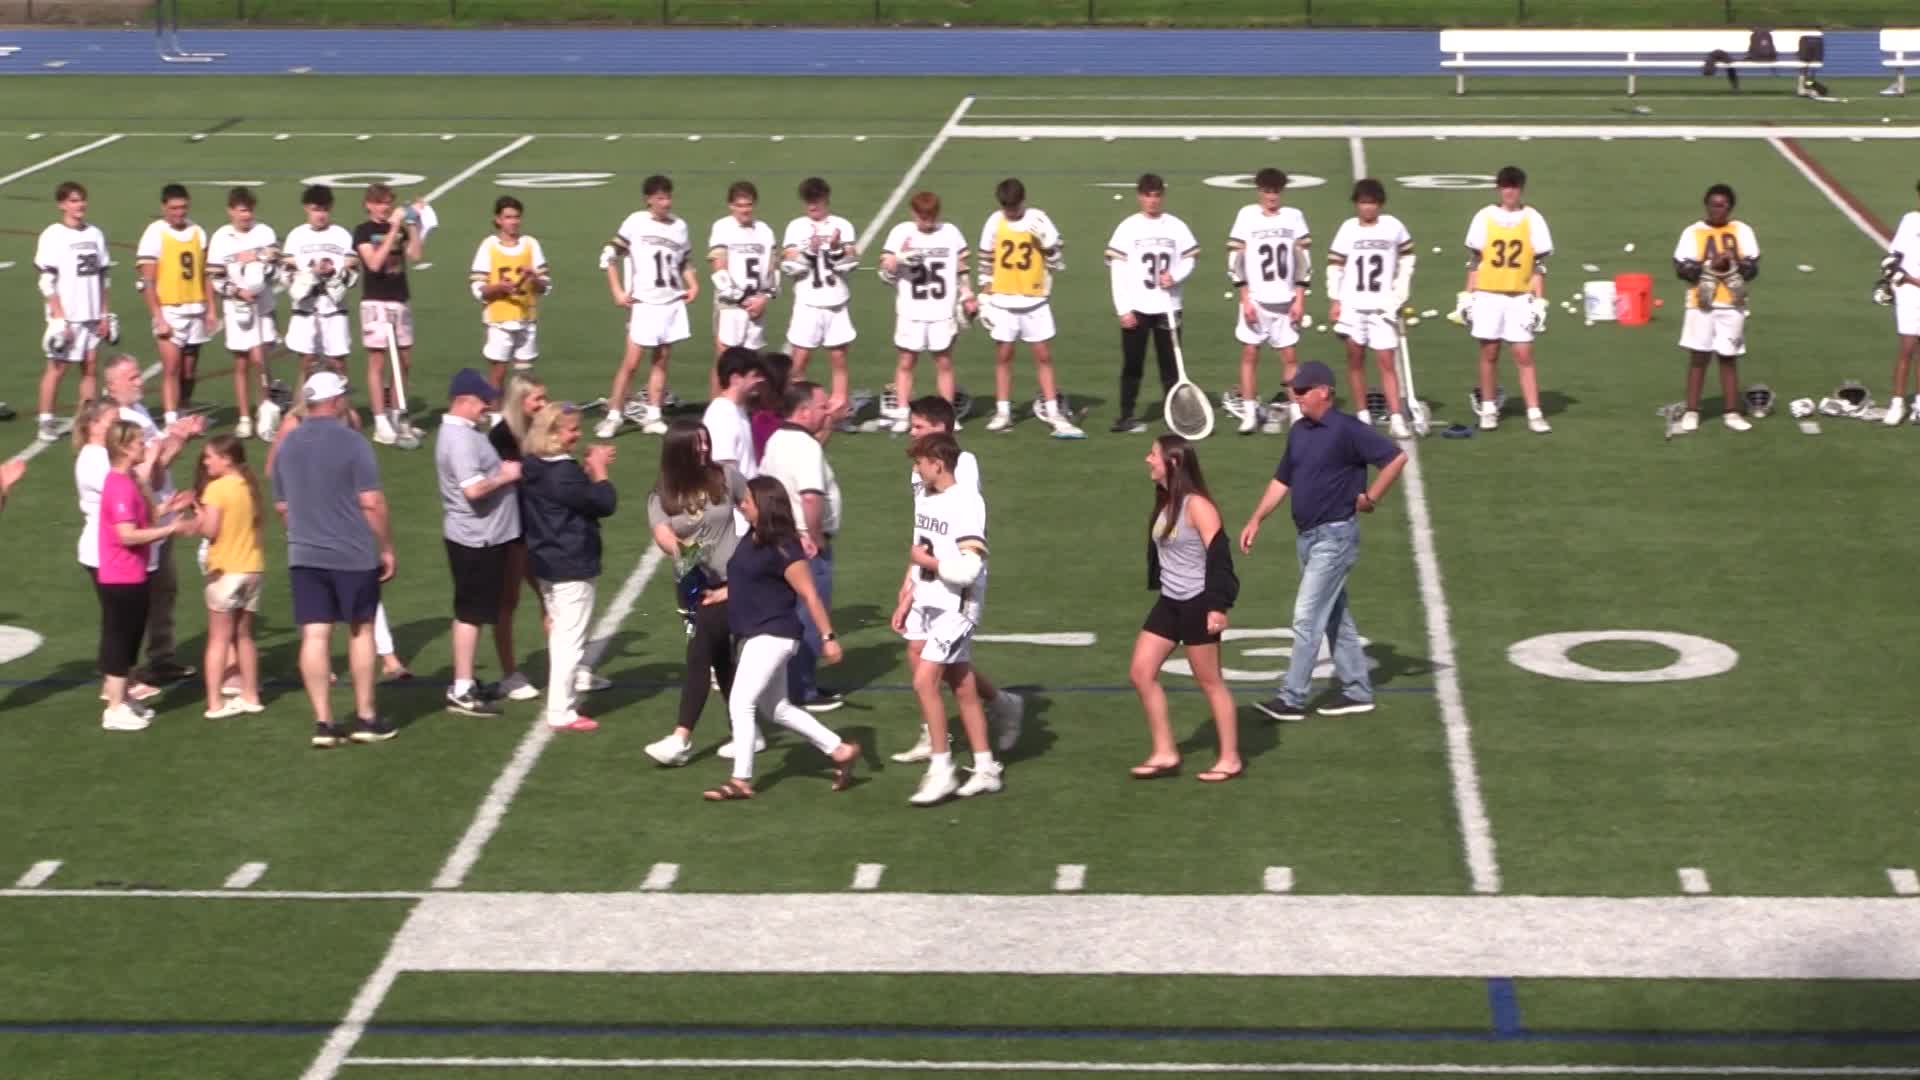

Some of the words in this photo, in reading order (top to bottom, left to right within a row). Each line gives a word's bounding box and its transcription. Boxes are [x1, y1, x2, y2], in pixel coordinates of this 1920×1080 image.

[180, 251, 193, 280] 9
[1001, 239, 1033, 270] 23
[1258, 243, 1288, 282] 20
[1491, 239, 1522, 268] 32
[746, 258, 760, 292] 5
[910, 261, 946, 300] 25
[1355, 254, 1383, 292] 12
